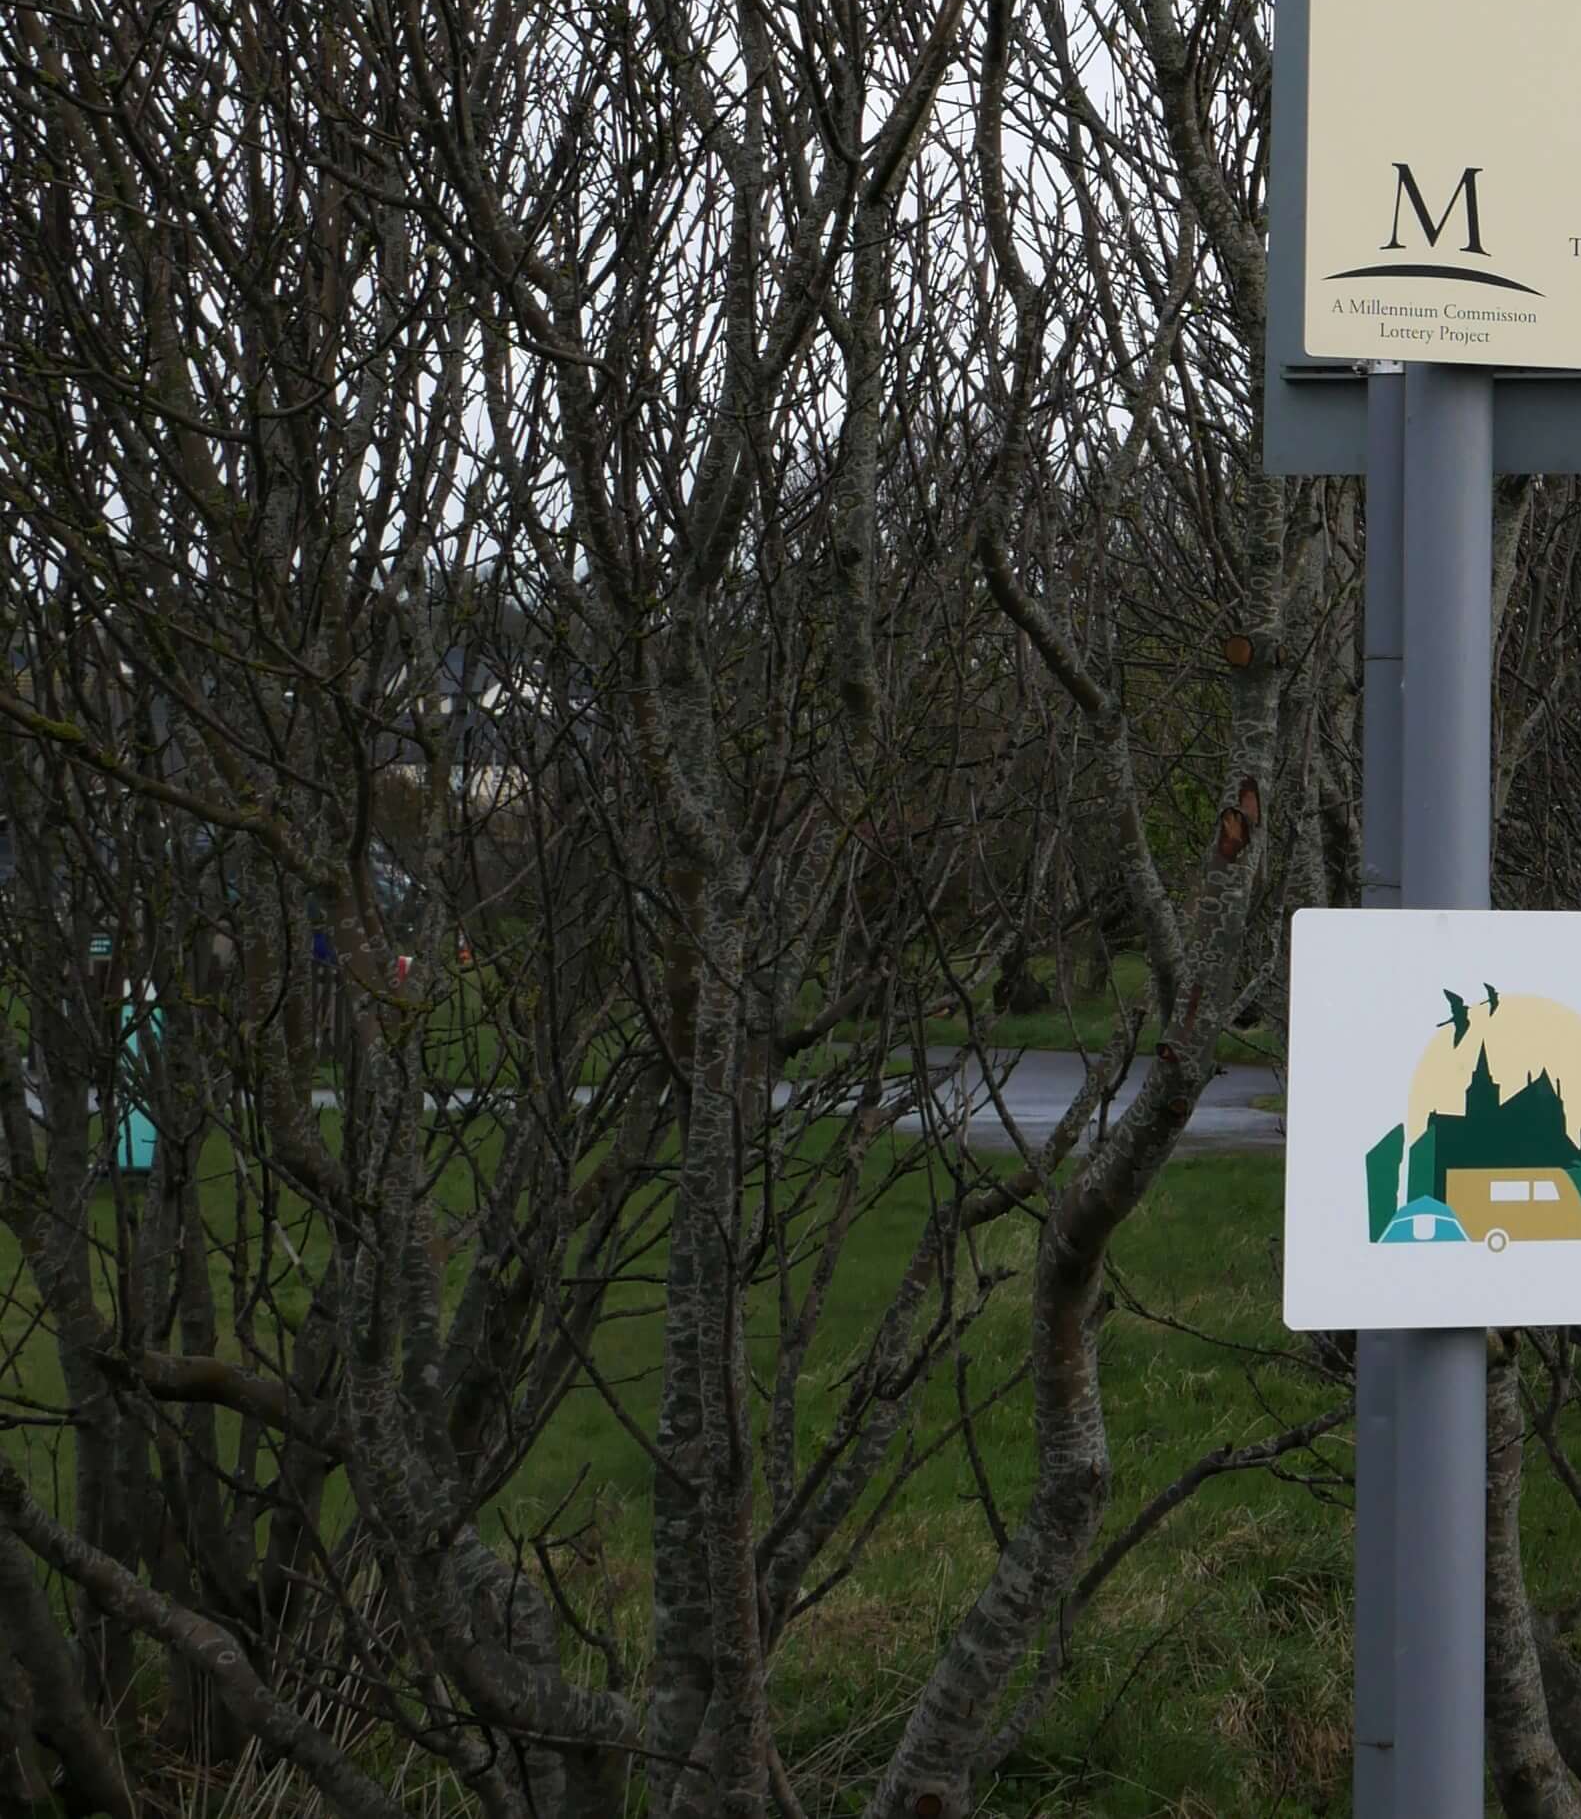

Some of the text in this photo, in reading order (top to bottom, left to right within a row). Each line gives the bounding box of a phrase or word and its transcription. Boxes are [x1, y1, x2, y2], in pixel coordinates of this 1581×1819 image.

[1331, 298, 1537, 324] A Millennium Commission
[1380, 322, 1490, 345] Lottery Project
